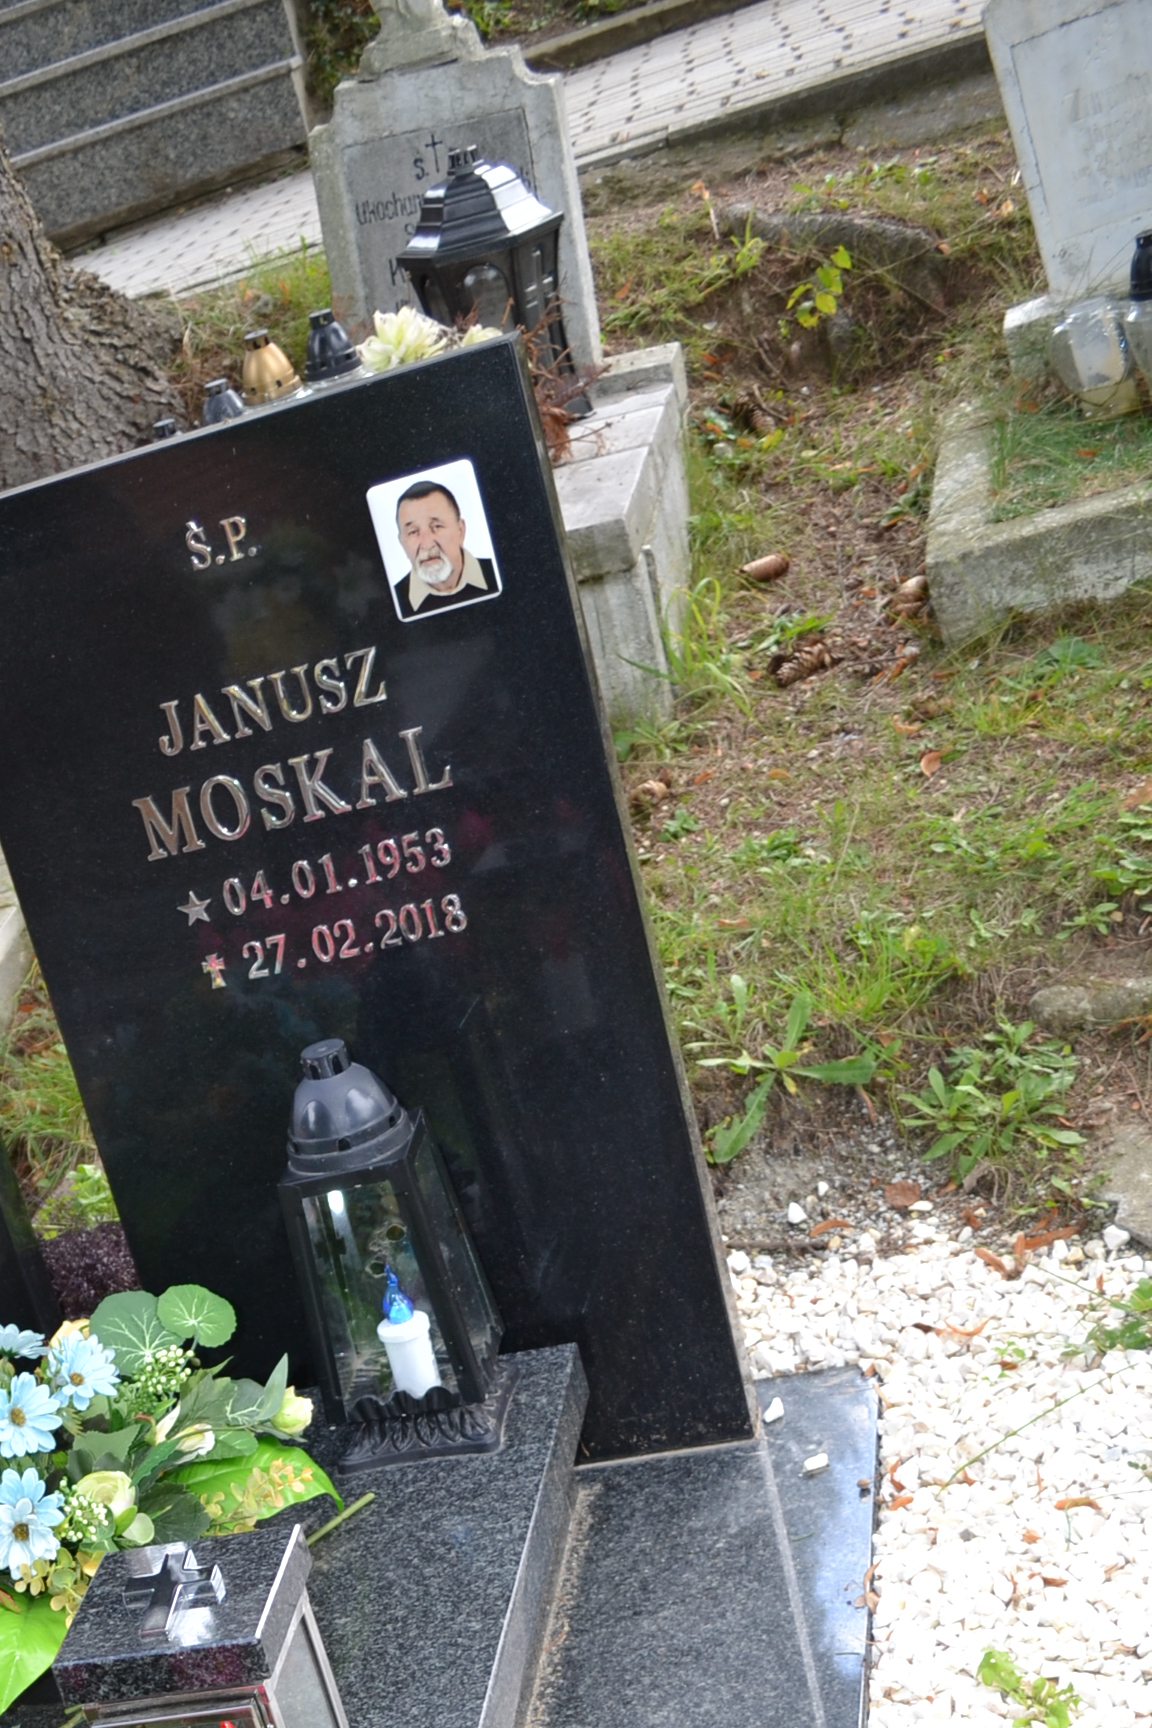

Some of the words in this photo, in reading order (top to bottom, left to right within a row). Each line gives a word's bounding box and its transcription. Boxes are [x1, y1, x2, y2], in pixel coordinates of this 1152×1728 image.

[157, 646, 387, 757] JANUSZ
[132, 726, 454, 862] MOSKAL
[222, 827, 452, 916] 04.01.1953
[242, 894, 468, 980] 27.02.2018
